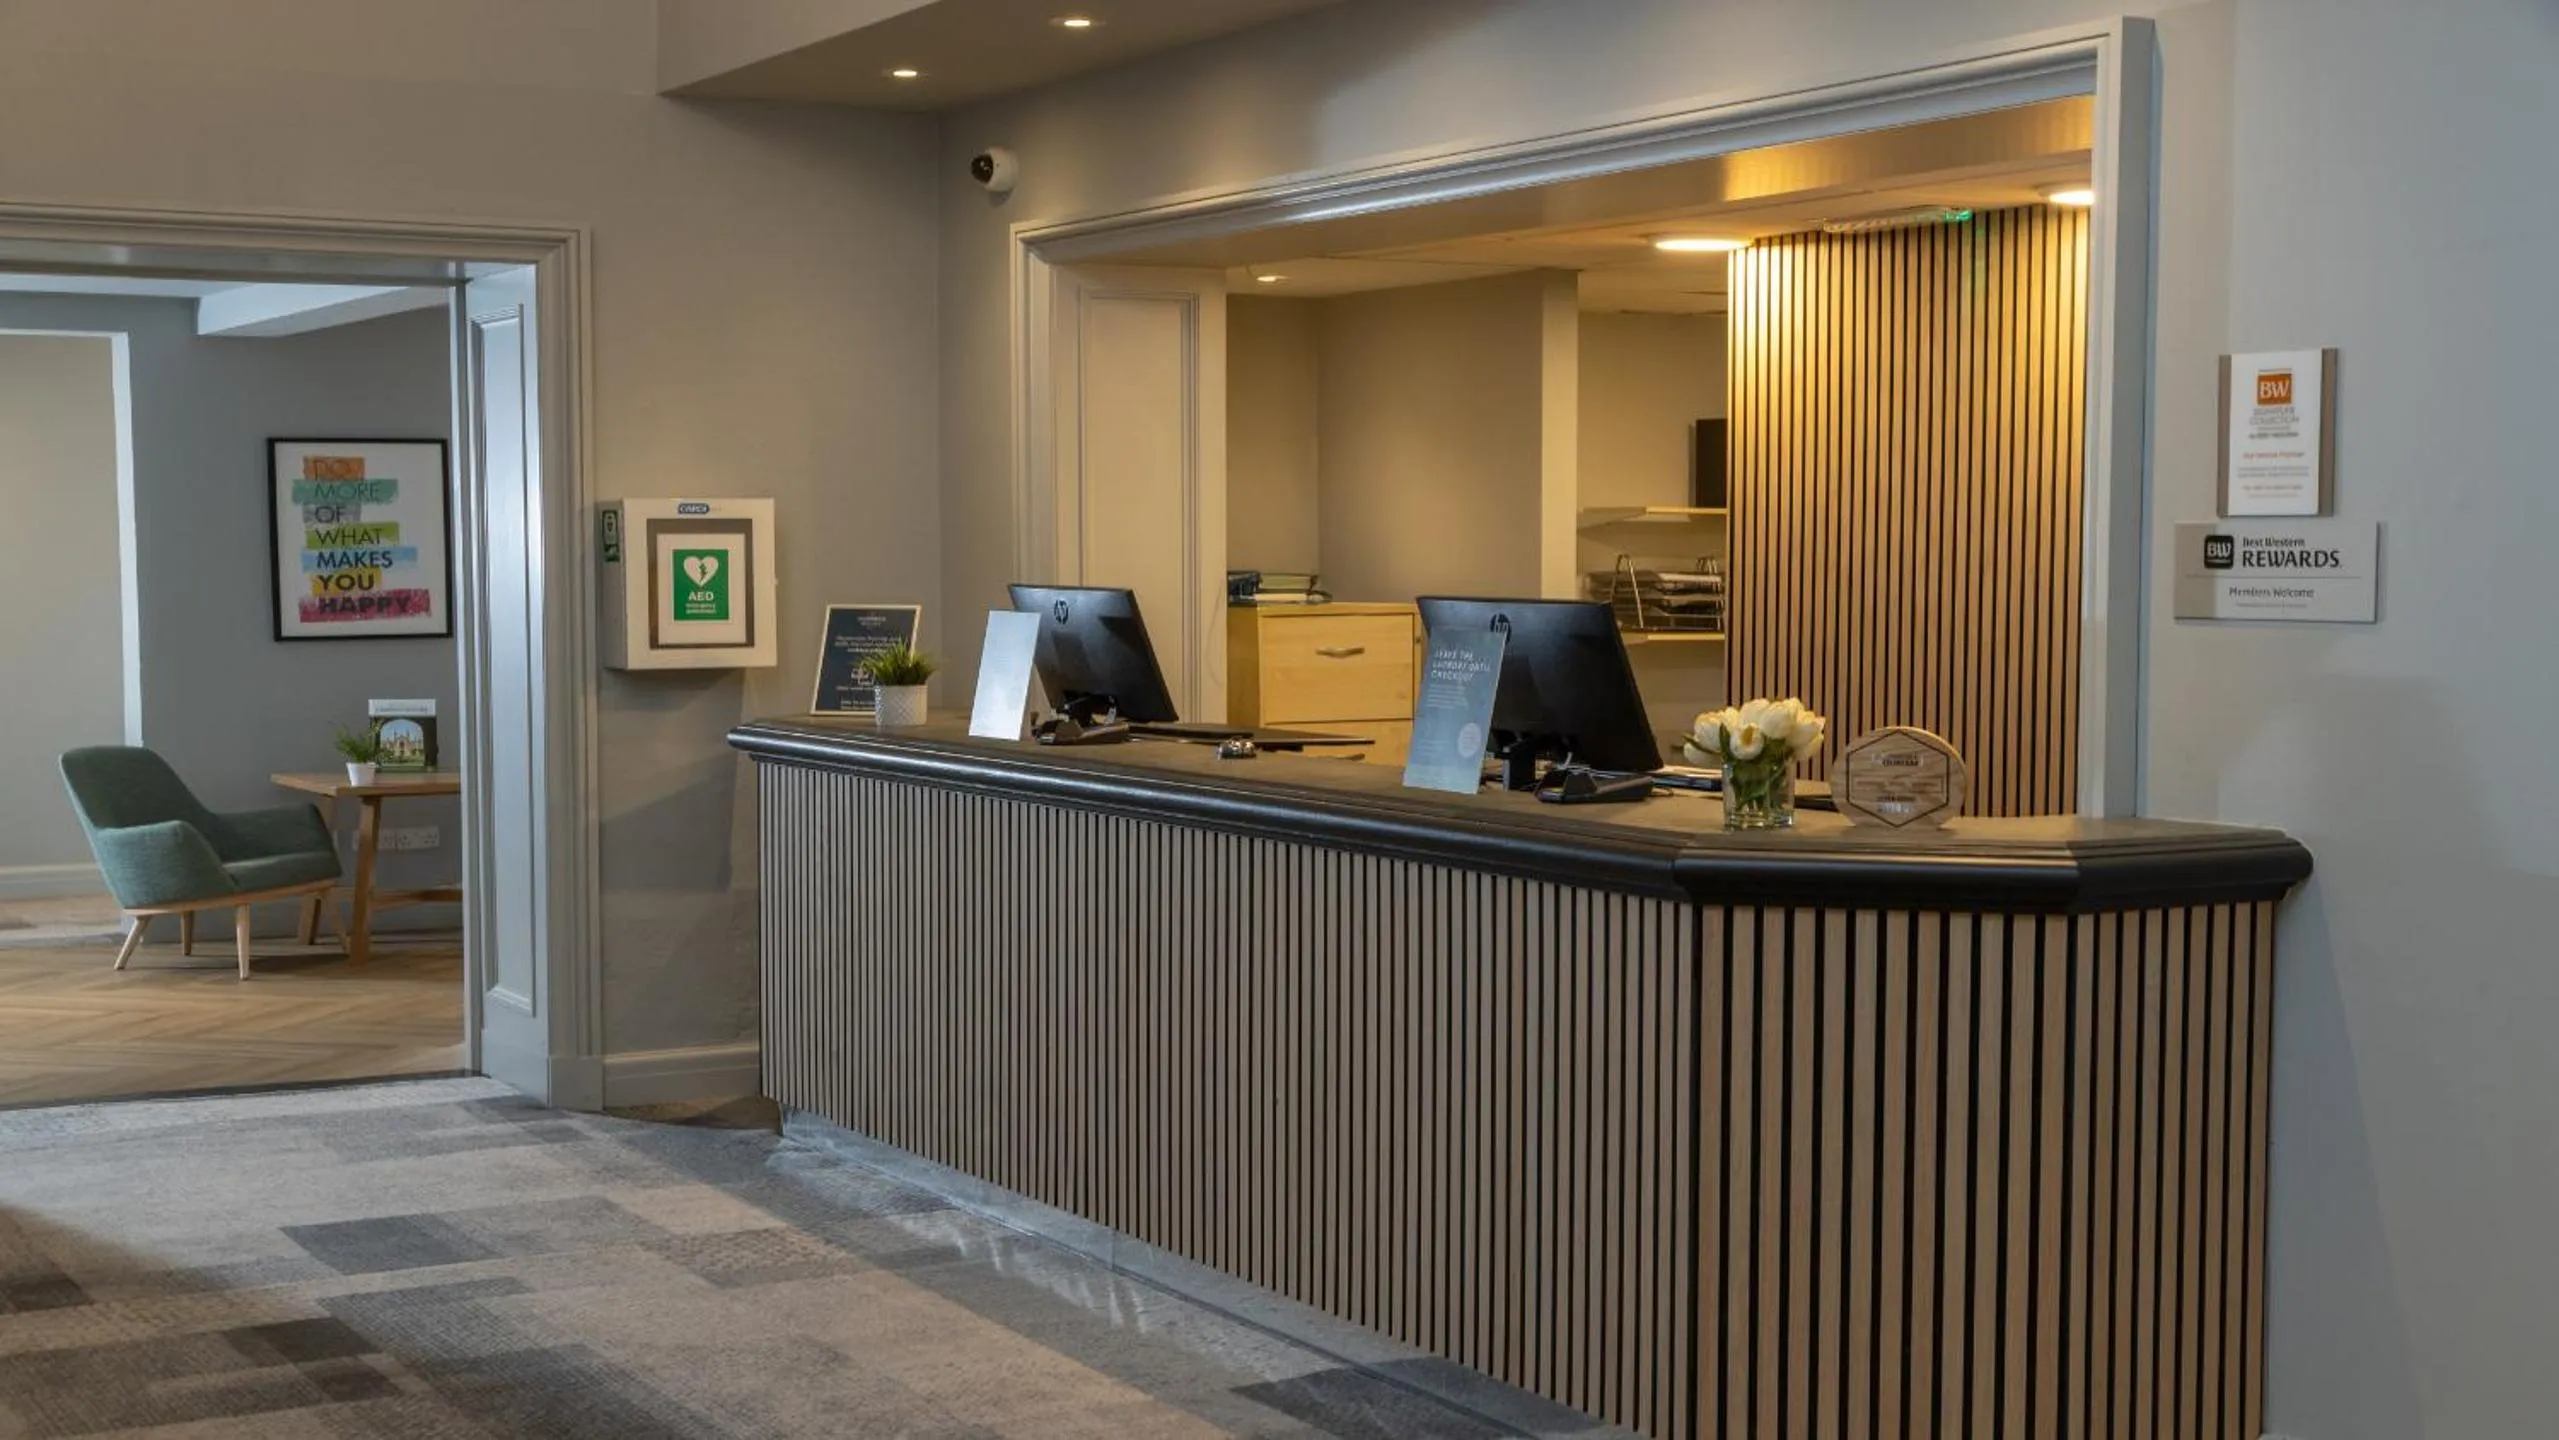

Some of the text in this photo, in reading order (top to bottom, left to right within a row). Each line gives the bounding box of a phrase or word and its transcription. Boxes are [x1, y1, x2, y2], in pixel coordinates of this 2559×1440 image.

[2260, 380, 2290, 399] BW
[313, 460, 351, 480] DO
[314, 482, 381, 501] MORE
[314, 505, 348, 523] OF
[314, 528, 385, 545] WHAT
[2243, 537, 2305, 547] Best Western
[2207, 541, 2232, 558] BW
[316, 551, 393, 569] MAKES
[2242, 550, 2340, 568] REWARDS
[316, 574, 375, 591] YOU
[317, 595, 412, 614] HAPPY
[688, 591, 715, 601] AED
